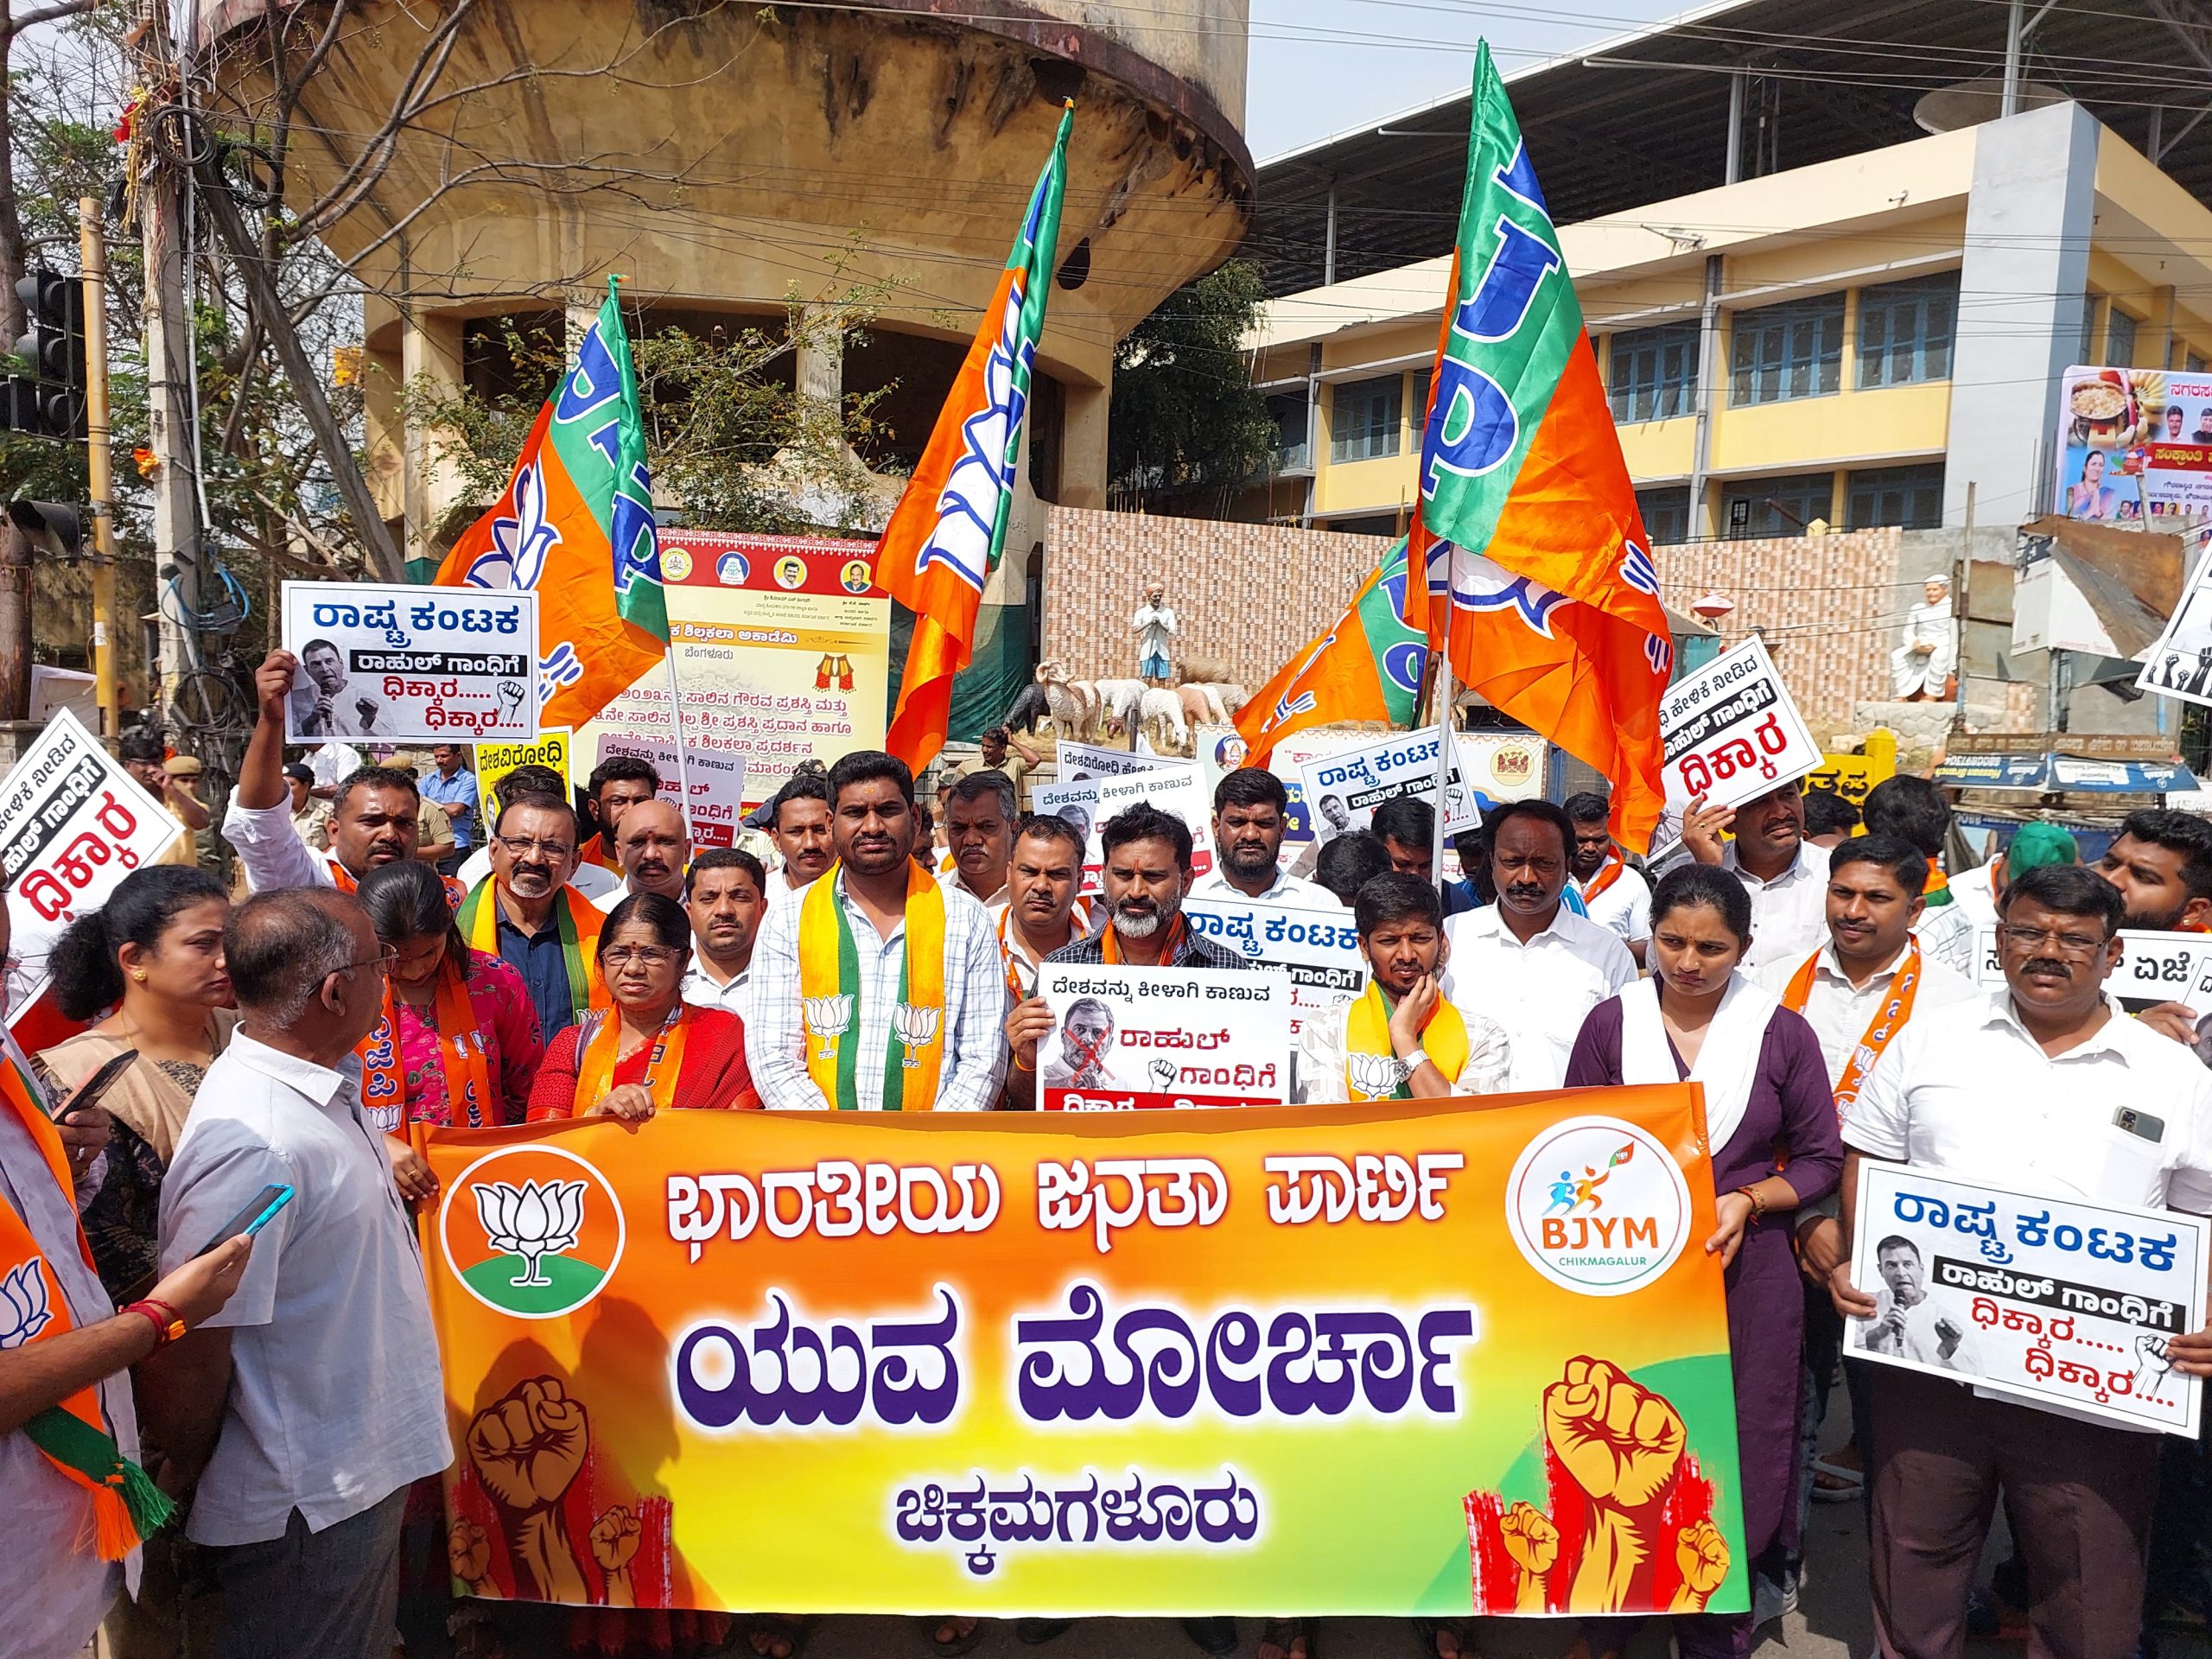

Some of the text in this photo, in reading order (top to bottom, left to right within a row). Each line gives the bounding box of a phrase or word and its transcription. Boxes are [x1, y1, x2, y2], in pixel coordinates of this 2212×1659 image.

[2170, 383, 2212, 397] ನಗರಸ
[313, 600, 519, 648] ರಾಷ್ಟ್ರ ಕಂಟಕ
[683, 622, 734, 643] ಶಿಲ್ಪಕಲಾ
[737, 629, 798, 645] ಅಕಾಡೆಮಿ
[358, 652, 520, 677] ರಾಹುಲ್ ಗಾಂಧಿಗೆ
[684, 646, 734, 660] ಬೆಂಗಳೂರು
[1670, 654, 1758, 718] ಹೇಳಿಕೆ ನೀಡಿದ
[686, 691, 729, 706] ಸಾಲಿನ
[733, 692, 772, 708] ಗೌರವ
[777, 696, 812, 715] ಪ್ರಶಸ್ತಿ
[815, 698, 848, 717] ಮತ್ತು
[1713, 680, 1775, 728] ಗಾಂಧಿಗೆ
[627, 709, 671, 724] ಸಾಲಿನ
[722, 714, 760, 734] ಪ್ರಶಸ್ತಿ
[762, 718, 808, 735] ಪ್ರದಾನ
[810, 721, 852, 735] ಹಾಗೂ
[32, 734, 76, 788] ನೀಡಿದ
[480, 741, 563, 772] ದೇಶವಿರೋಧಿ
[605, 743, 735, 772] ದೇಶವನ್ನು ಕೀಳಗಿ ಕಾಣುವ
[756, 739, 813, 756] ಪ್ರದರ್ಶನ
[1678, 711, 1788, 802] ಧಿಕ್ಕಾರ
[744, 761, 796, 775] ಮಾರಂ
[1064, 751, 1120, 777] ದೇಶವಿರೋಧಿ
[1317, 756, 1380, 788] ರಾಷ್ಟ್ರ
[41, 759, 103, 830] ಗಾಂಧಿಗೆ
[1042, 775, 1193, 805] ದೇಶವನ್ನು ಕೀಳಾಗಿ ಕಾಣುವ
[1351, 785, 1404, 809] ರಾಹುಲ್
[19, 790, 140, 923] ಧಿಕ್ಕಾರ
[1186, 912, 1358, 957] ರಾಷ್ಟ್ರ ಕಂಟಕ
[1291, 967, 1357, 988] ಗಾಂಧಿಗೆ
[2134, 950, 2196, 983] ಏಜೆ
[1052, 976, 1134, 1004] ದೇಶವನ್ನು
[1137, 981, 1199, 999] ಕೀಳಾಗಿ
[1205, 985, 1270, 1002] ಕಾಣುವ
[1120, 1027, 1231, 1051] ರಾಹುಲ್
[1179, 1062, 1277, 1091] ಗಾಂಧಿಗೆ
[667, 1153, 1465, 1264] ಭಾರತೀಯ ಜನತಾ ಪಾರ್ಟಿ
[1541, 1217, 1659, 1250] BJYM
[1892, 1191, 2177, 1273] ರಾಷ್ಟ್ರ ಕಂಟಕ
[1559, 1256, 1647, 1267] CHIKMAGALUR
[1941, 1262, 2175, 1329] ರಾಹುಲ್ ಗಾಂಧಿಗೆ
[676, 1285, 1474, 1427] ಯುವ ಮೋರ್ಚಾ
[895, 1470, 1259, 1576] ಚಿಕ್ಕಮಗಳೂರು
